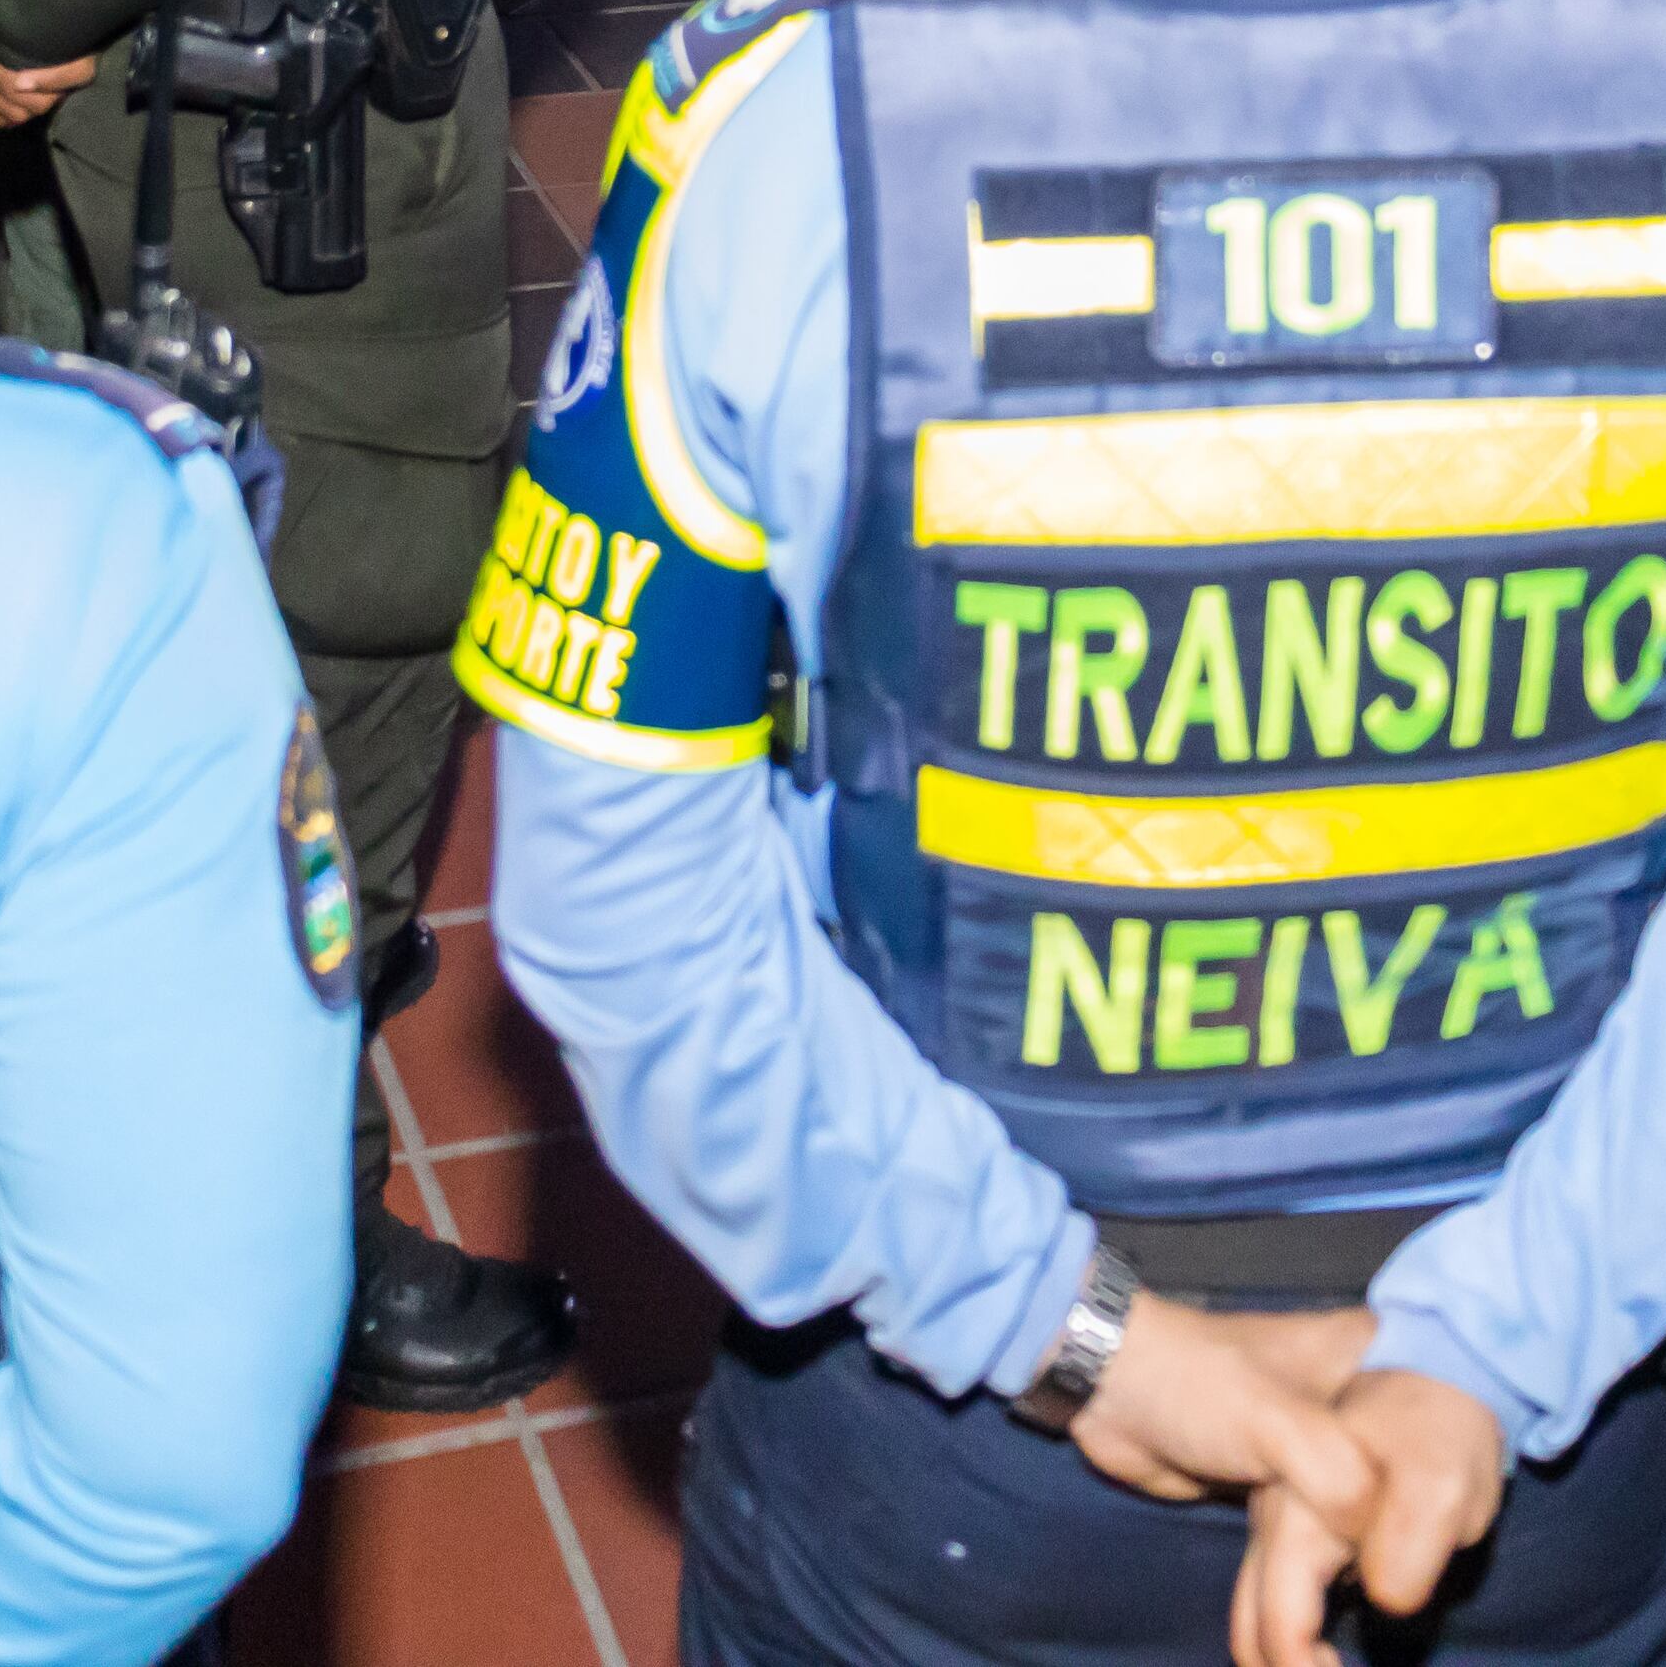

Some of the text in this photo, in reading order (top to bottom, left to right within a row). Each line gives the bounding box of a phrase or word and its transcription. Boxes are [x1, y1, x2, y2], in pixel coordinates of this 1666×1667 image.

[1205, 193, 1439, 336] 101
[601, 531, 662, 627] Y
[1020, 892, 1555, 1076] NEIVA
